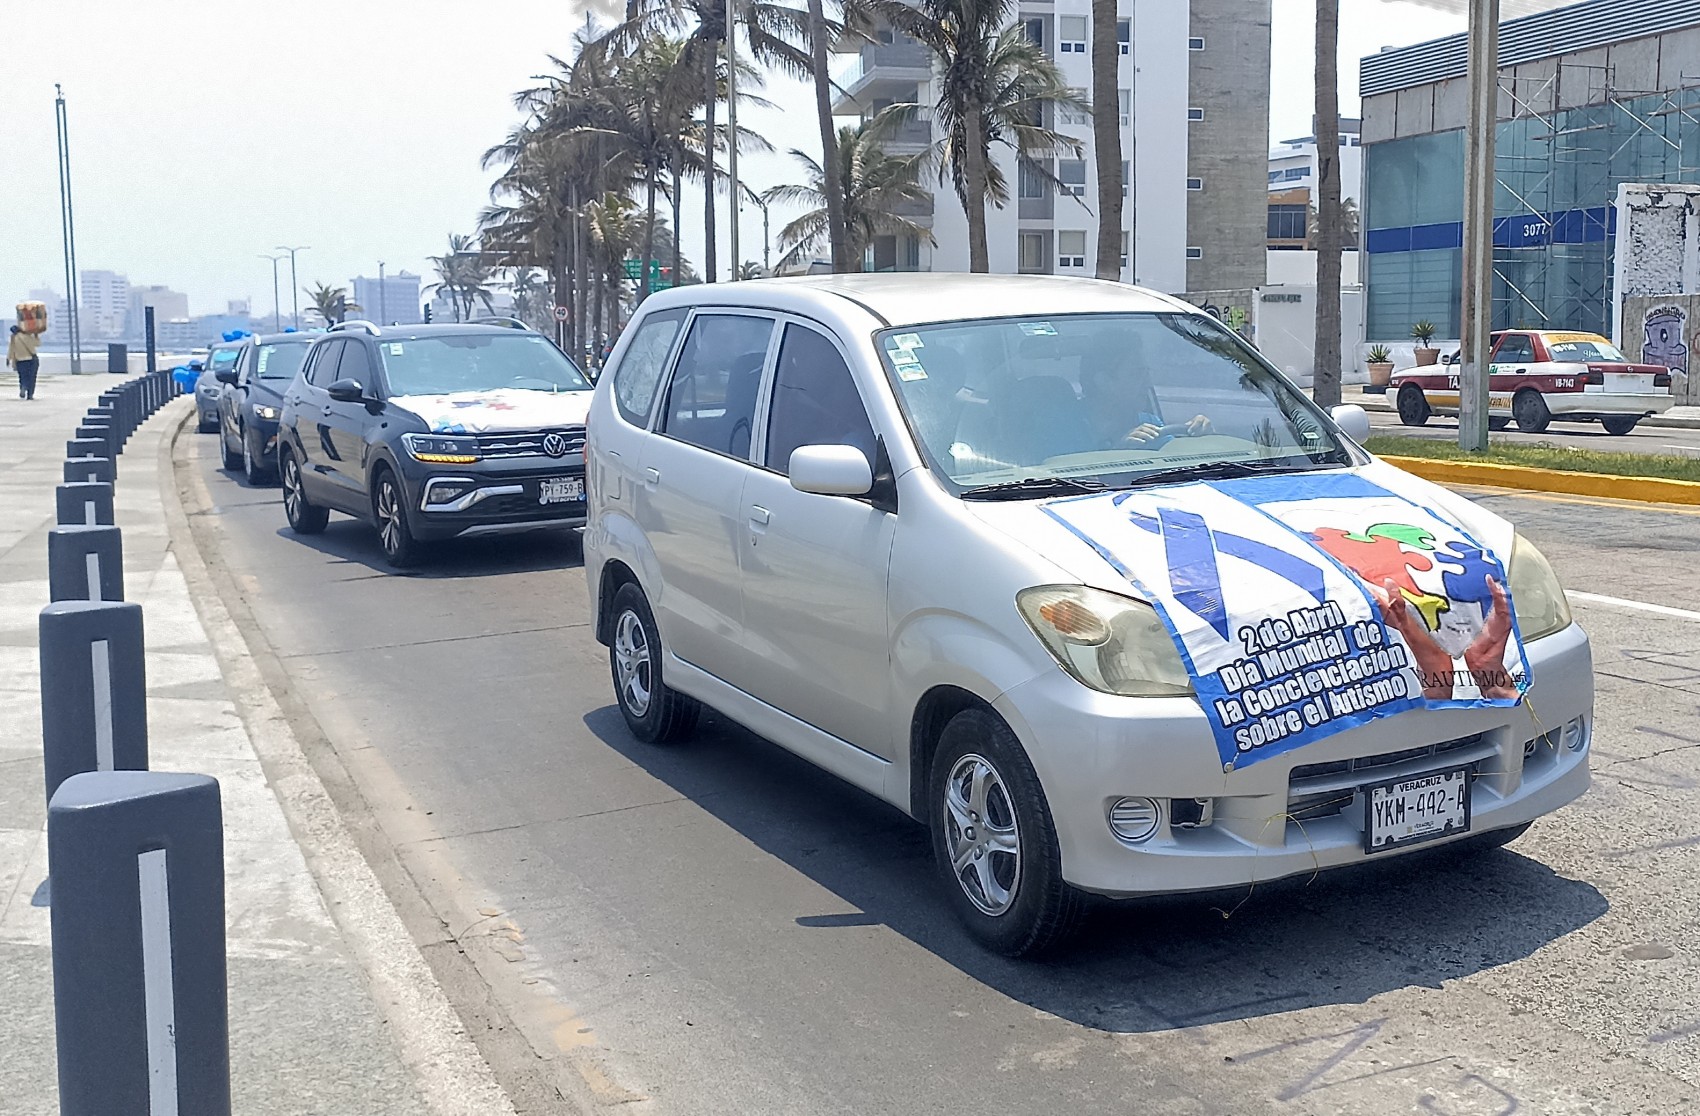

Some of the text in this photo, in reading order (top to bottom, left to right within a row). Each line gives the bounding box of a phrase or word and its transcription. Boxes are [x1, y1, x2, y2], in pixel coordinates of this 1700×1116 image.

[1523, 222, 1546, 237] 3077
[1239, 600, 1346, 656] 2 de Abril
[1217, 621, 1381, 694] Día Mundial de
[1214, 697, 1246, 727] la
[1235, 673, 1407, 752] sobre el Autismo
[1375, 784, 1465, 828] YKM-442-A
[1399, 776, 1442, 792] VERACRUZ
